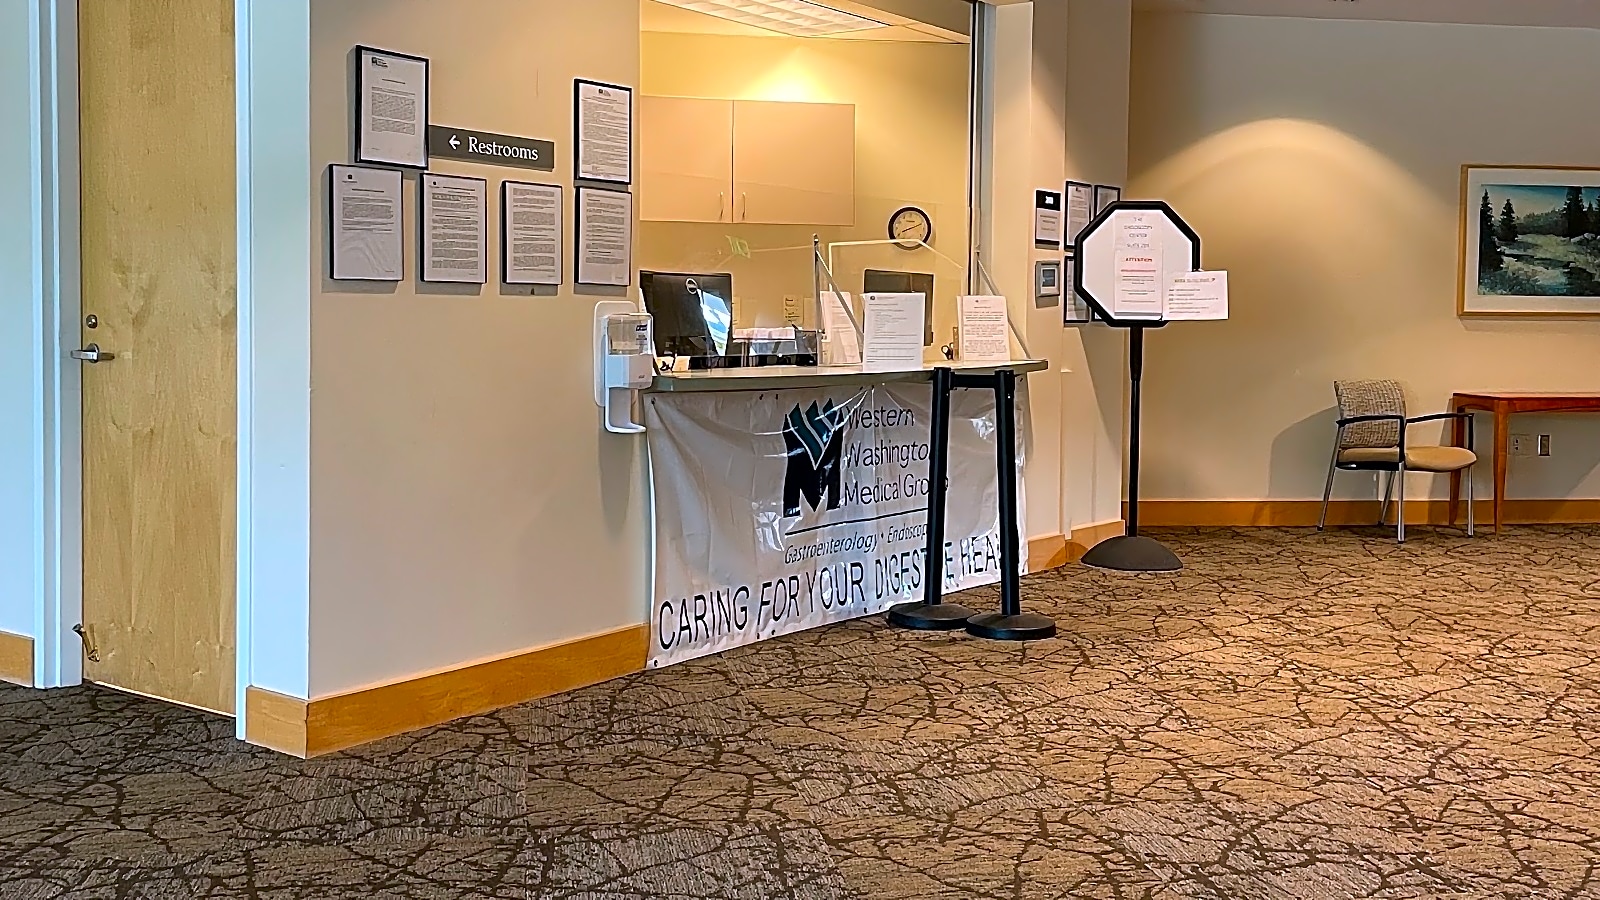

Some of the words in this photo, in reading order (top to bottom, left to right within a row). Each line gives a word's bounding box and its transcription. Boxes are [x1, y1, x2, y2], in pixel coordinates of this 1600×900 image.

[468, 136, 539, 160] Restrooms
[846, 406, 915, 430] Western
[845, 440, 929, 468] Washingto
[844, 475, 901, 507] Medical
[903, 473, 948, 498] Gro
[785, 532, 878, 564] Gastroenterology
[887, 523, 928, 544] Endoscop
[659, 585, 750, 650] CARING
[757, 575, 800, 625] FOR
[806, 562, 865, 610] YOUR
[875, 542, 955, 599] DIGESTE
[960, 533, 1000, 576] HEA
